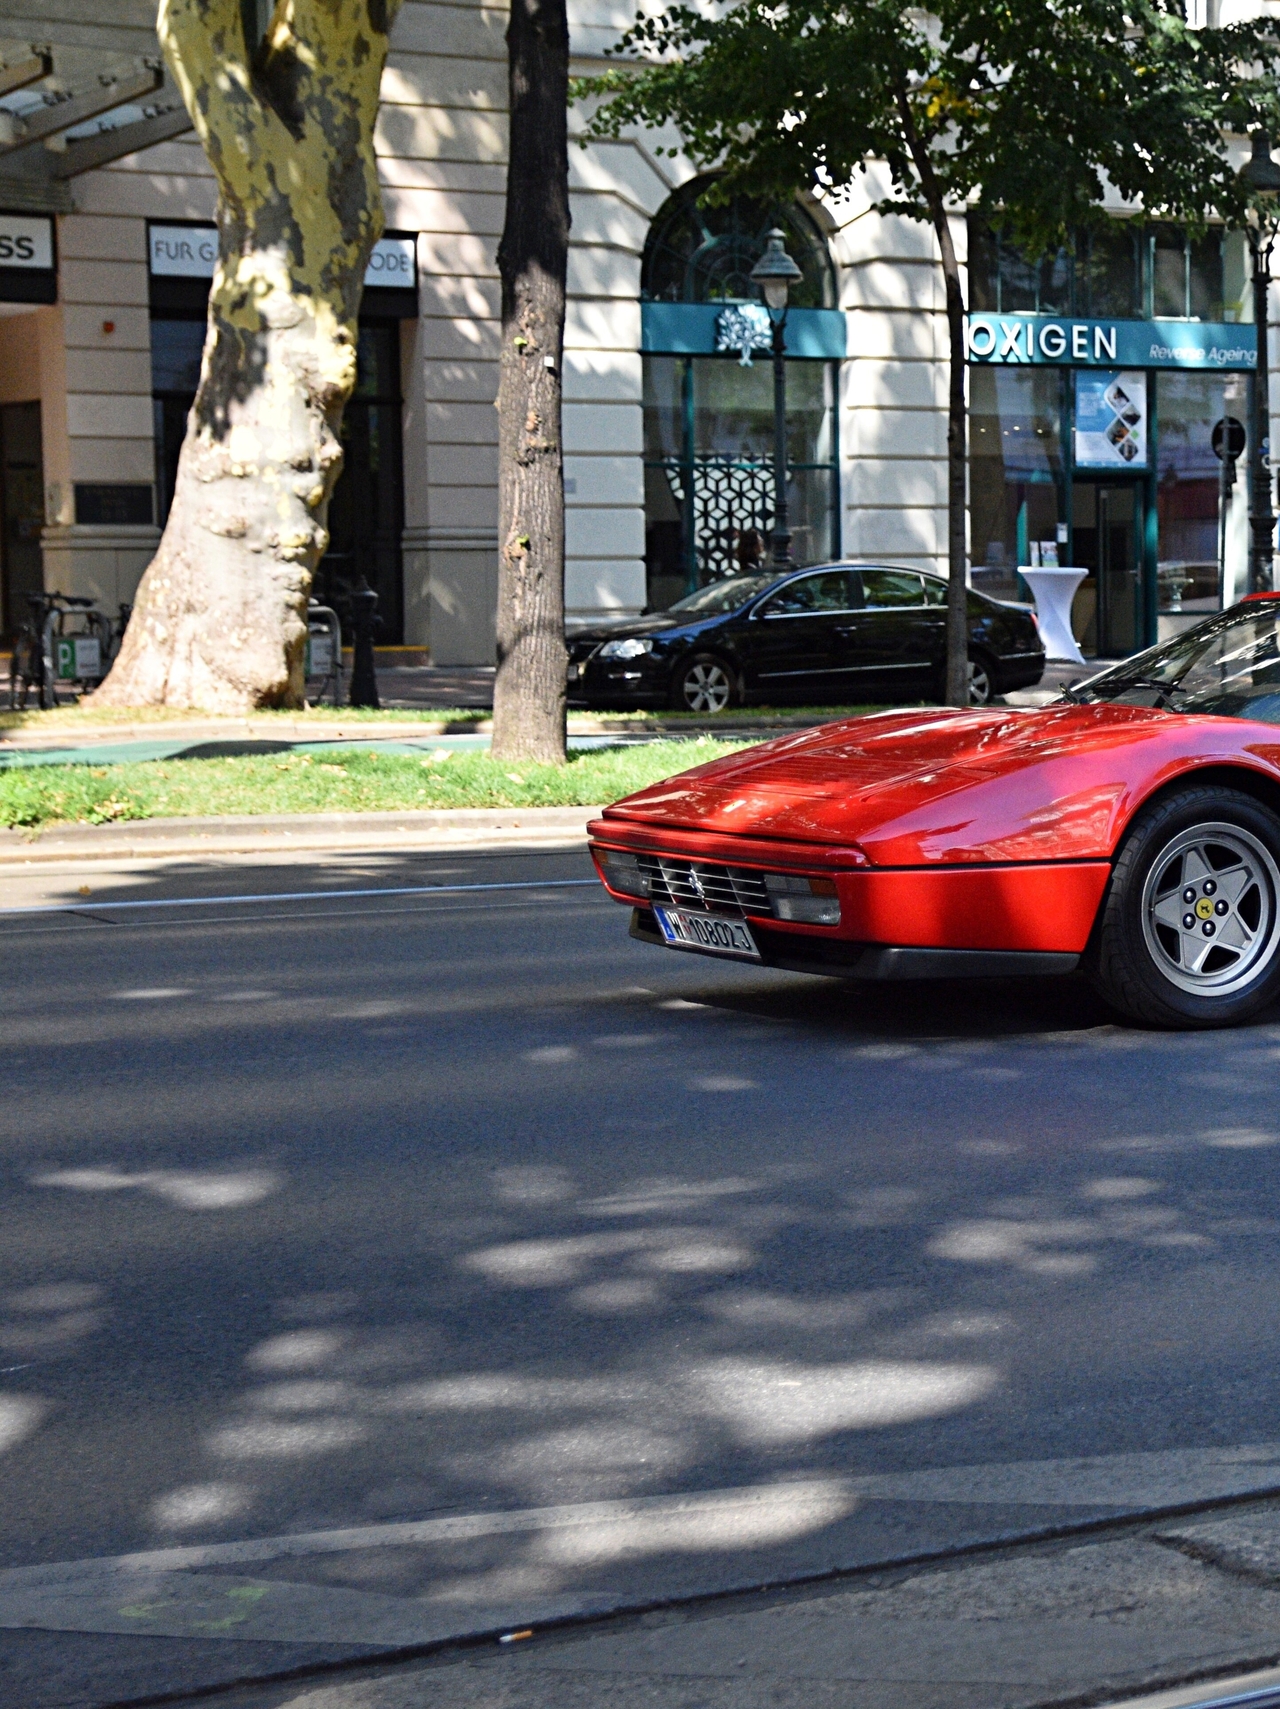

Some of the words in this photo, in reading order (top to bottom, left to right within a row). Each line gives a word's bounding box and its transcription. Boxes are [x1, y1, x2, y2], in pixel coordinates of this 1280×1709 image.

[155, 240, 195, 261] FUR
[369, 252, 410, 272] ODE
[968, 320, 1116, 359] OXIGEN
[1149, 344, 1205, 360] Reverse
[1208, 346, 1258, 365] Ageing
[58, 643, 71, 676] P
